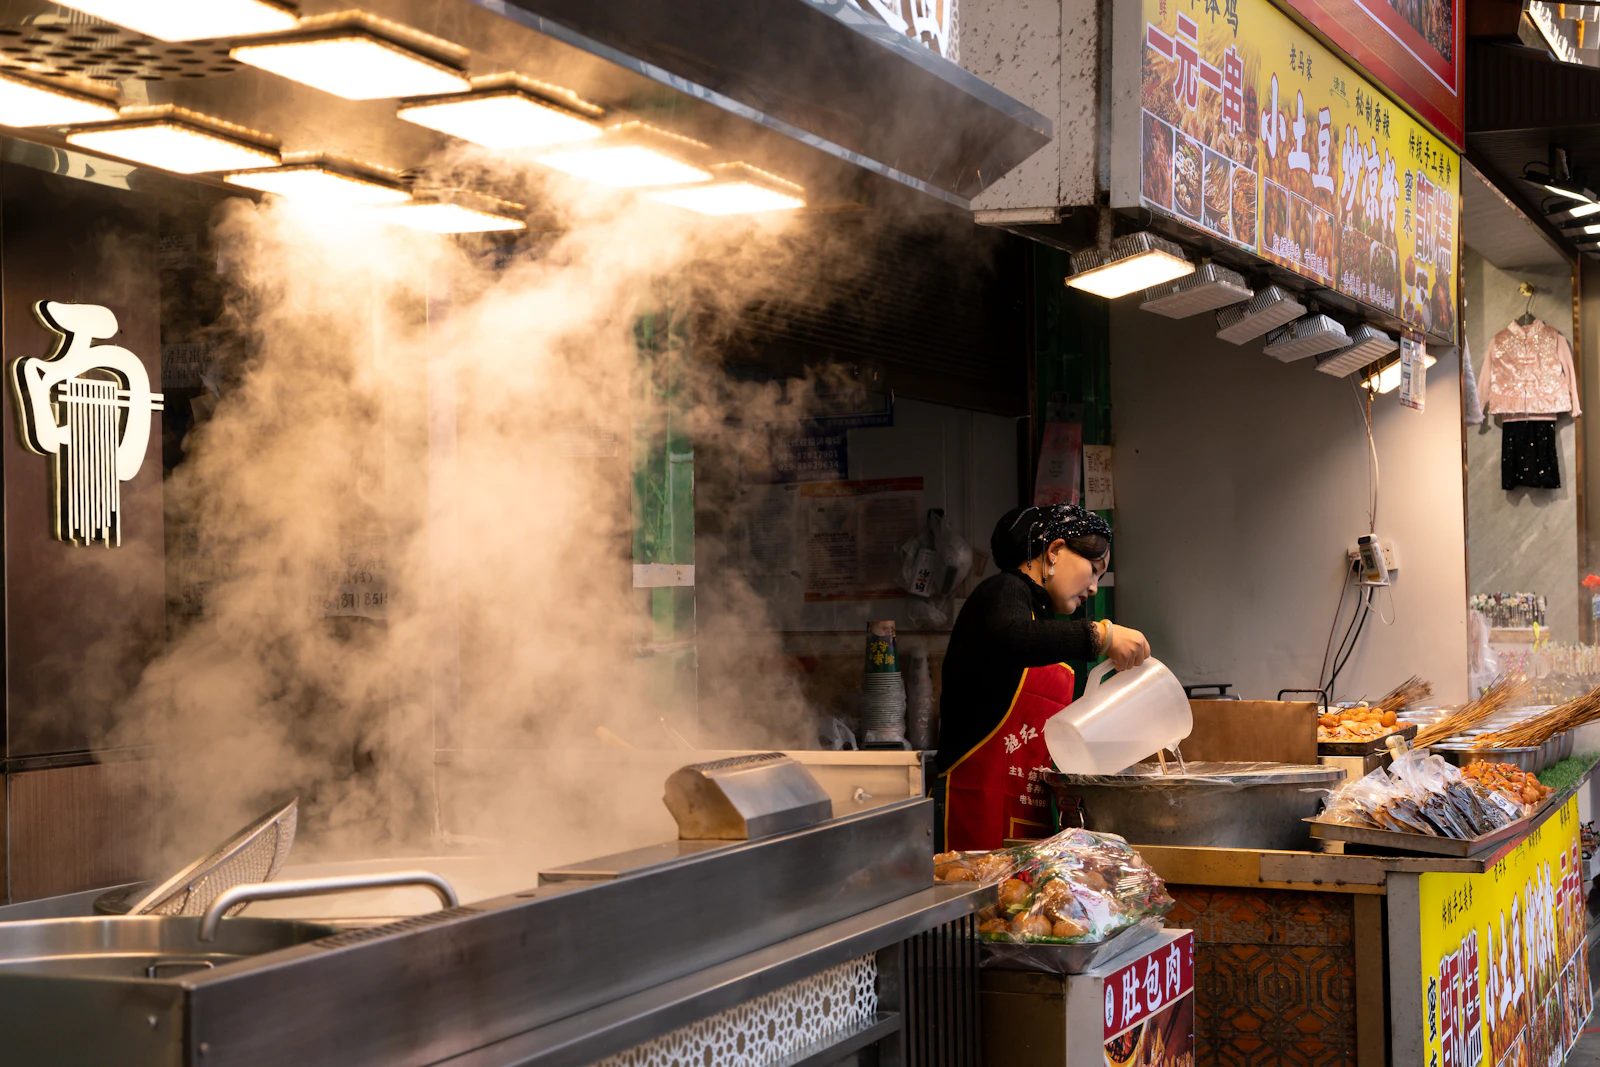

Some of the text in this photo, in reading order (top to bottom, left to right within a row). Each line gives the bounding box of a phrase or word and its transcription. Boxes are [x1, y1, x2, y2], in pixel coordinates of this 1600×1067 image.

[1146, 10, 1243, 138] 一元一串
[1289, 42, 1313, 82] 老马家
[1355, 87, 1391, 139] 秘制香辣
[1261, 72, 1335, 195] 小土豆
[1341, 123, 1400, 234] 炒凉粉
[1407, 127, 1452, 185] 传统手工美食
[1026, 782, 1044, 795] 各种
[1441, 877, 1473, 931] 传统手工美食
[1556, 837, 1582, 931] 一元一串
[1485, 857, 1555, 1032] 小土豆 炒凉粉
[1120, 941, 1182, 1029] 肚包肉
